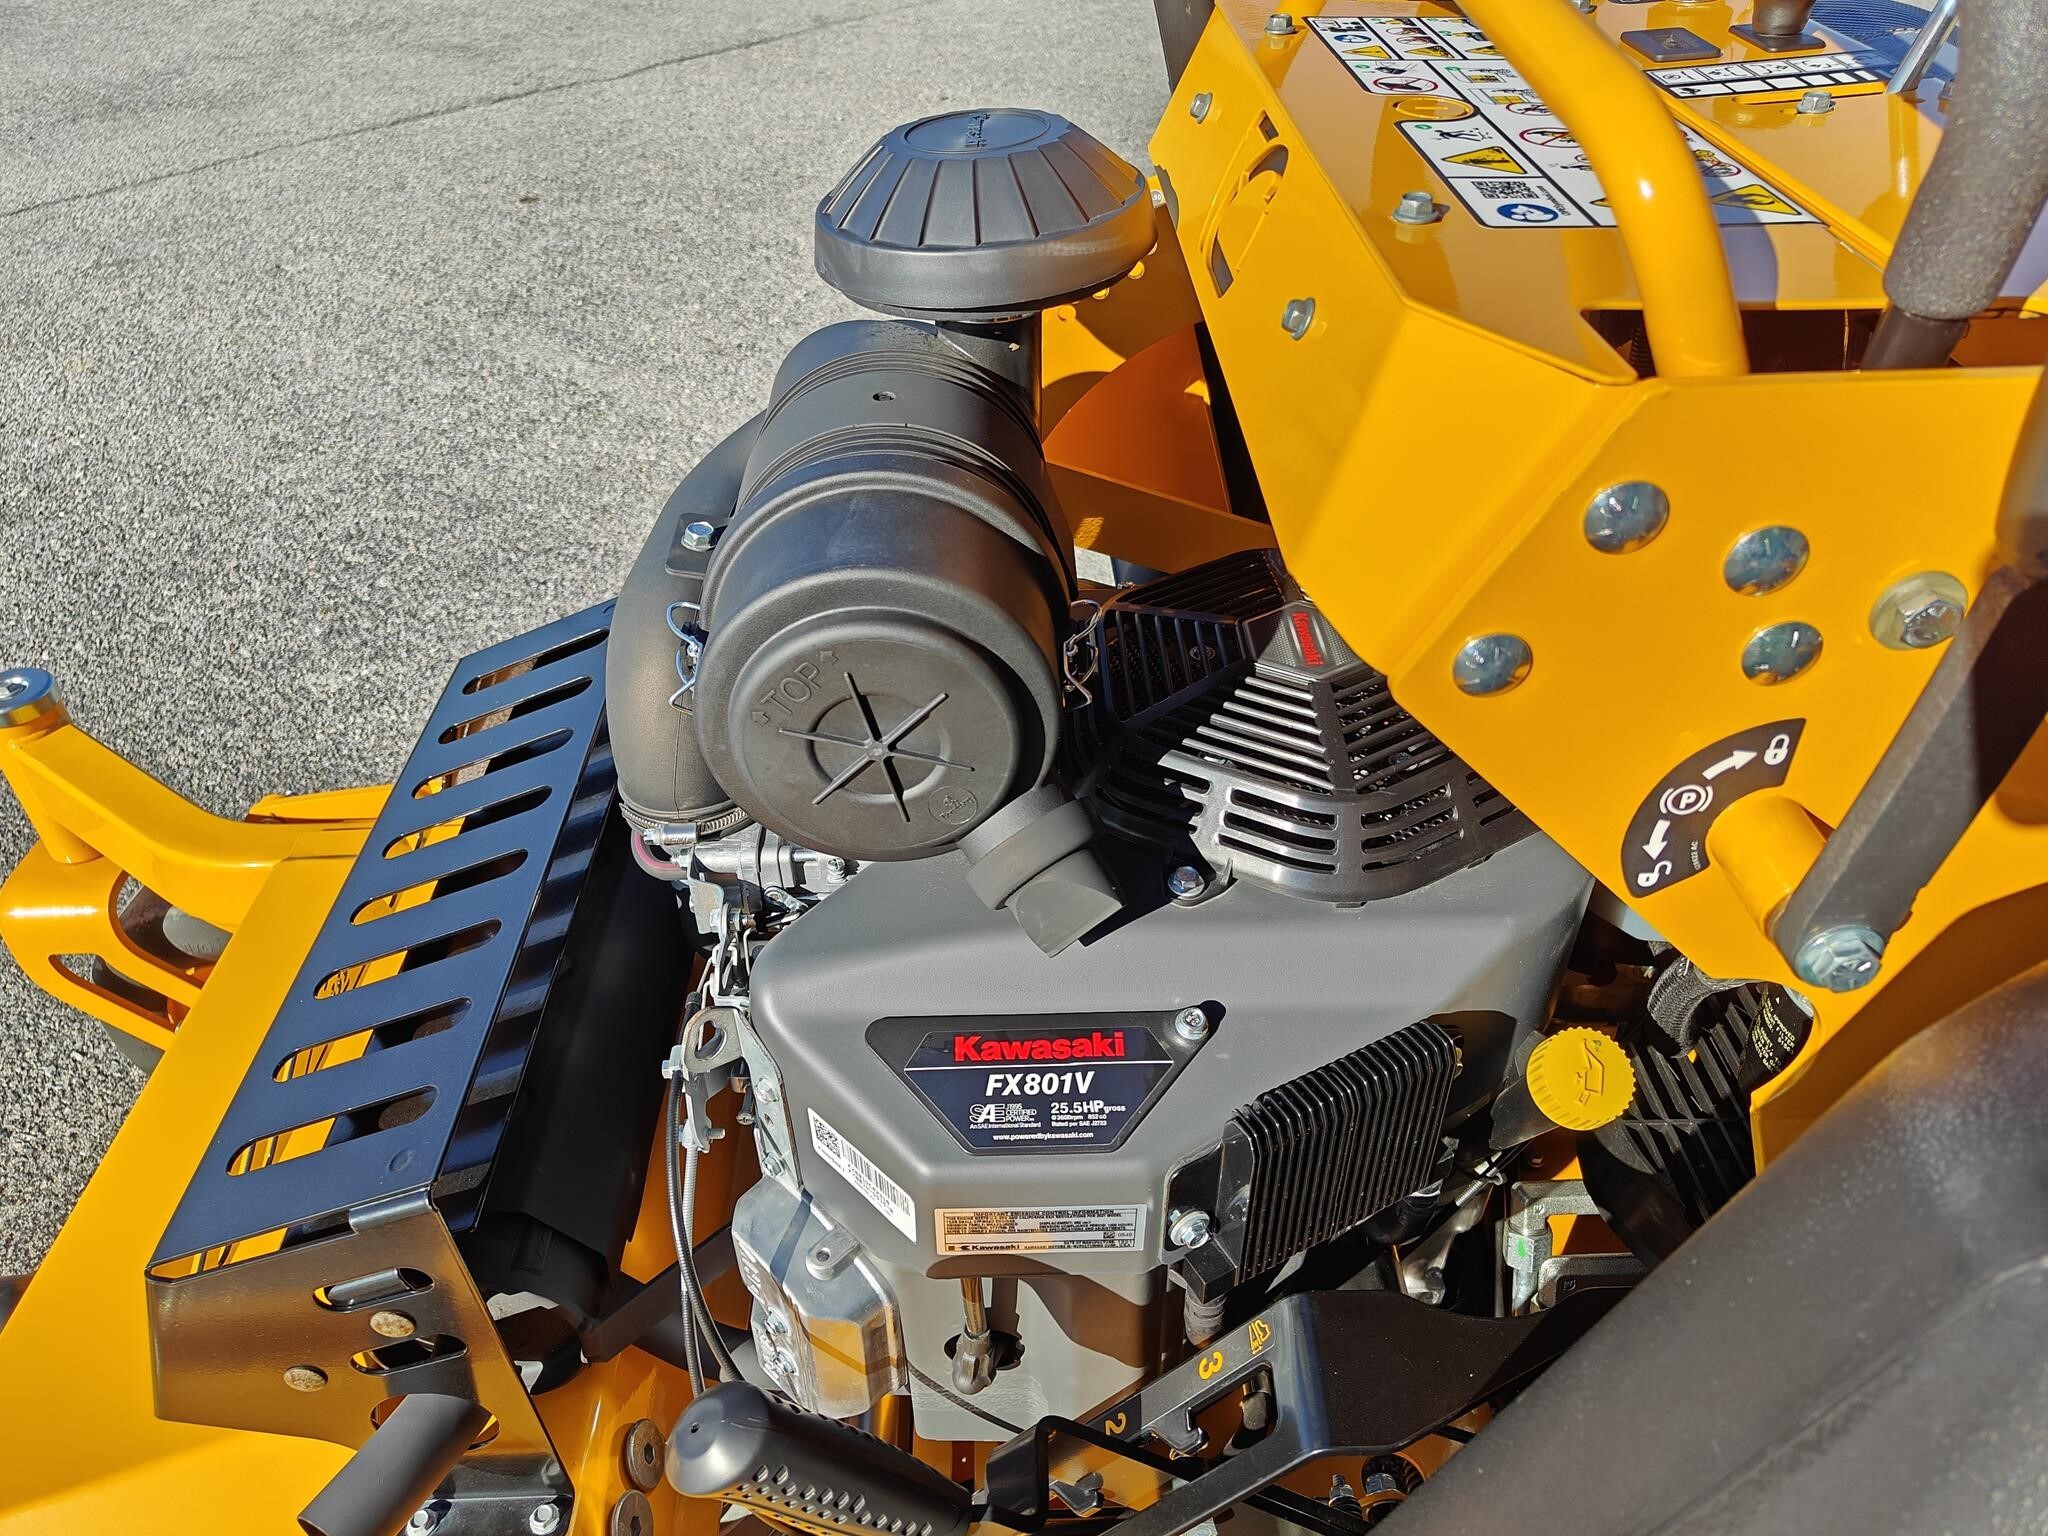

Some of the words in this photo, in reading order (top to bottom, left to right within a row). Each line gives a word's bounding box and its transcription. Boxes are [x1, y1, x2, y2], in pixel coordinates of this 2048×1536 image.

[1292, 612, 1325, 666] Kawasaki
[760, 661, 822, 715] TOP
[954, 1031, 1125, 1062] Kawasaki
[985, 1071, 1095, 1097] FX801V
[969, 1103, 1006, 1123] SAE
[992, 1131, 1094, 1141] www.poweredbykawasaki.com
[1198, 1351, 1224, 1380] 3
[1105, 1412, 1127, 1436] 2
